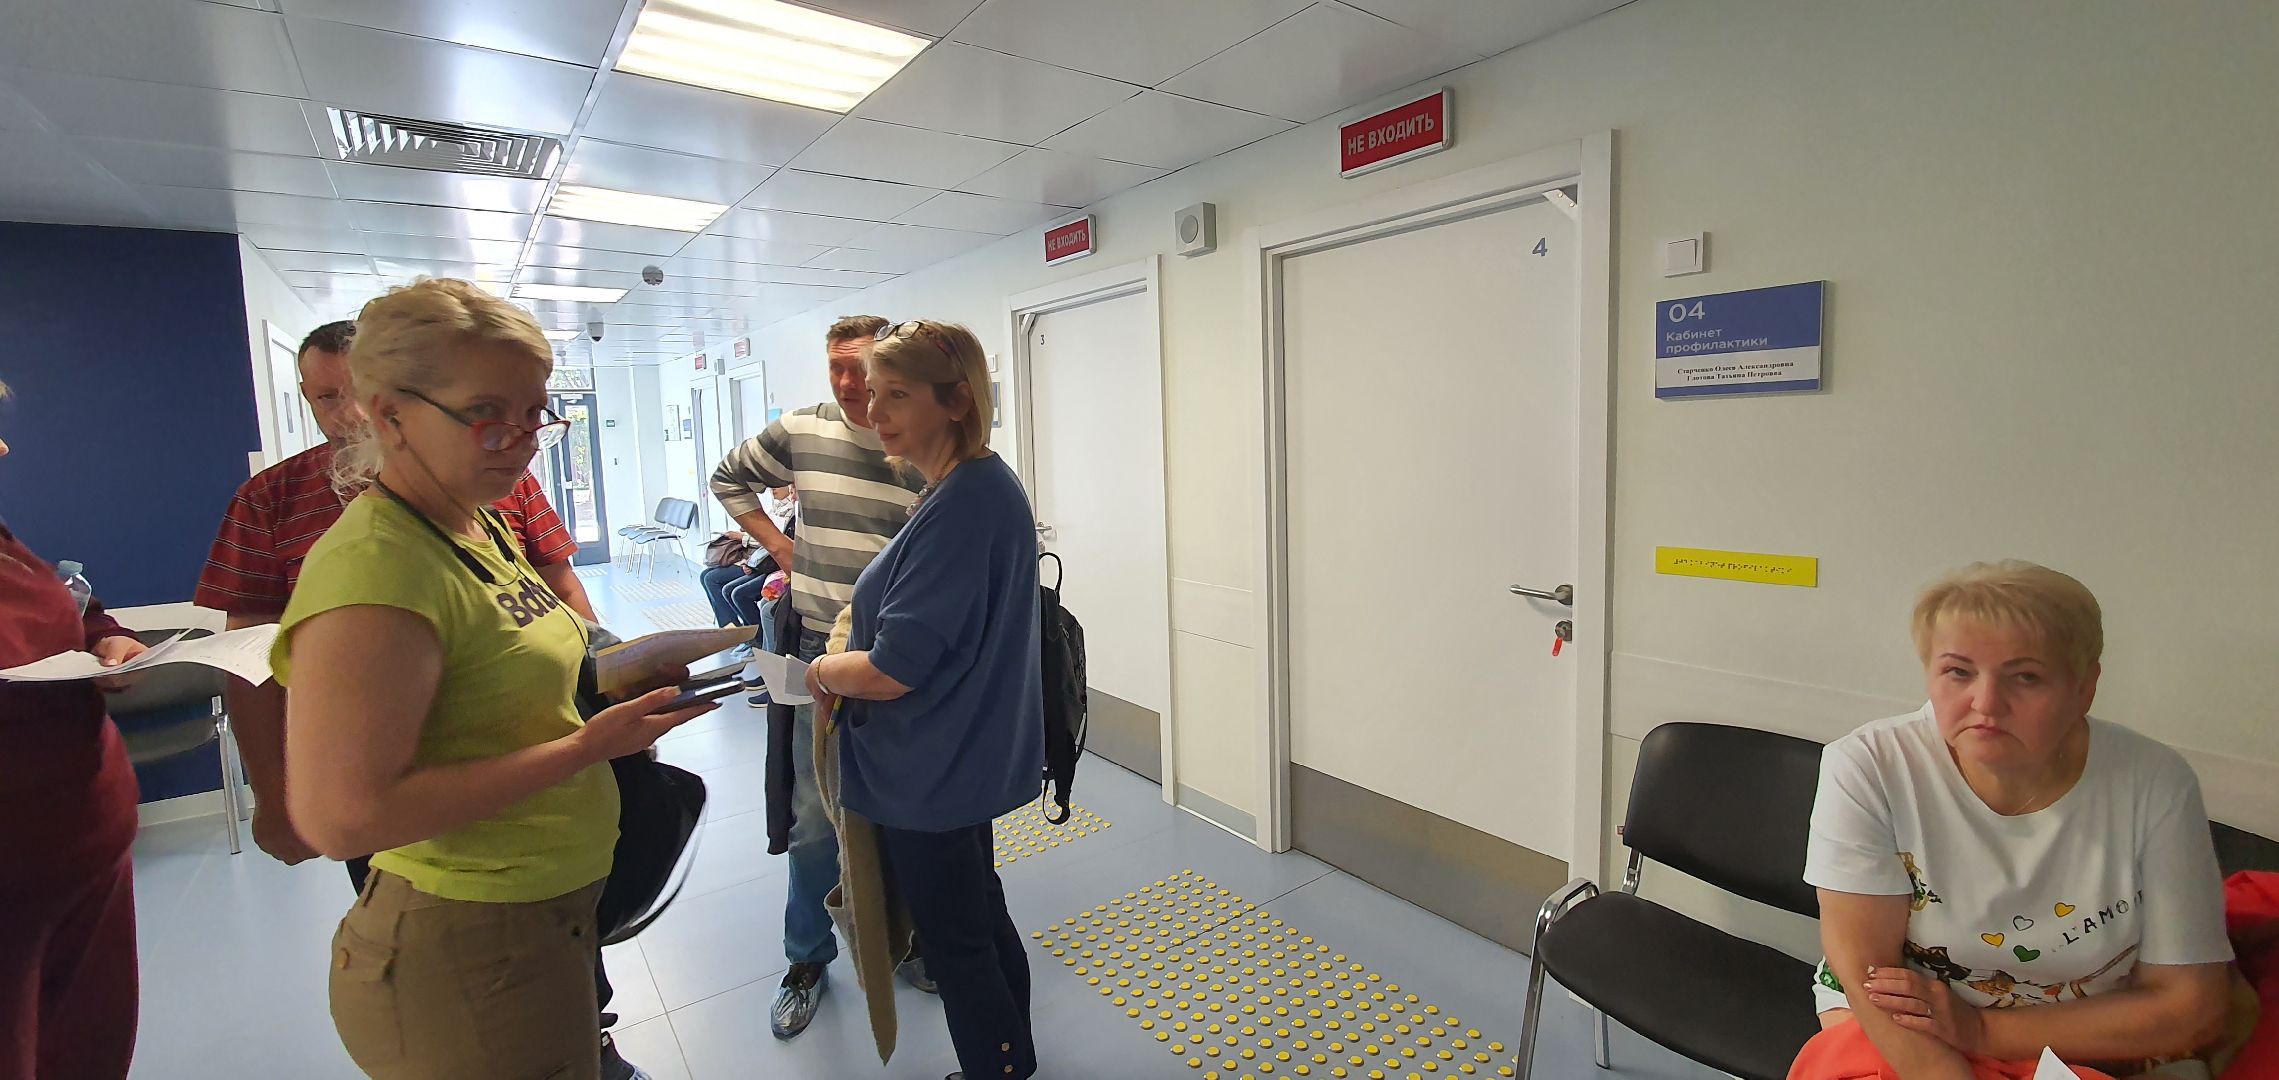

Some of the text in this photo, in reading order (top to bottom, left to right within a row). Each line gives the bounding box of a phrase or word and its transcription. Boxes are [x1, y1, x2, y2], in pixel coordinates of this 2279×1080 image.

[1347, 112, 1435, 156] НЕ ВХОДИТЬ
[1047, 229, 1086, 252] НЕ ВХОДИТЬ
[1532, 237, 1548, 256] 4
[1668, 300, 1706, 323] 04
[1040, 334, 1045, 346] 3
[1665, 328, 1723, 342] Кабинет
[1665, 336, 1769, 354] профилактики
[1717, 372, 1746, 380] Татьяна
[1747, 370, 1782, 379] Петровна
[1738, 361, 1794, 371] Александровна
